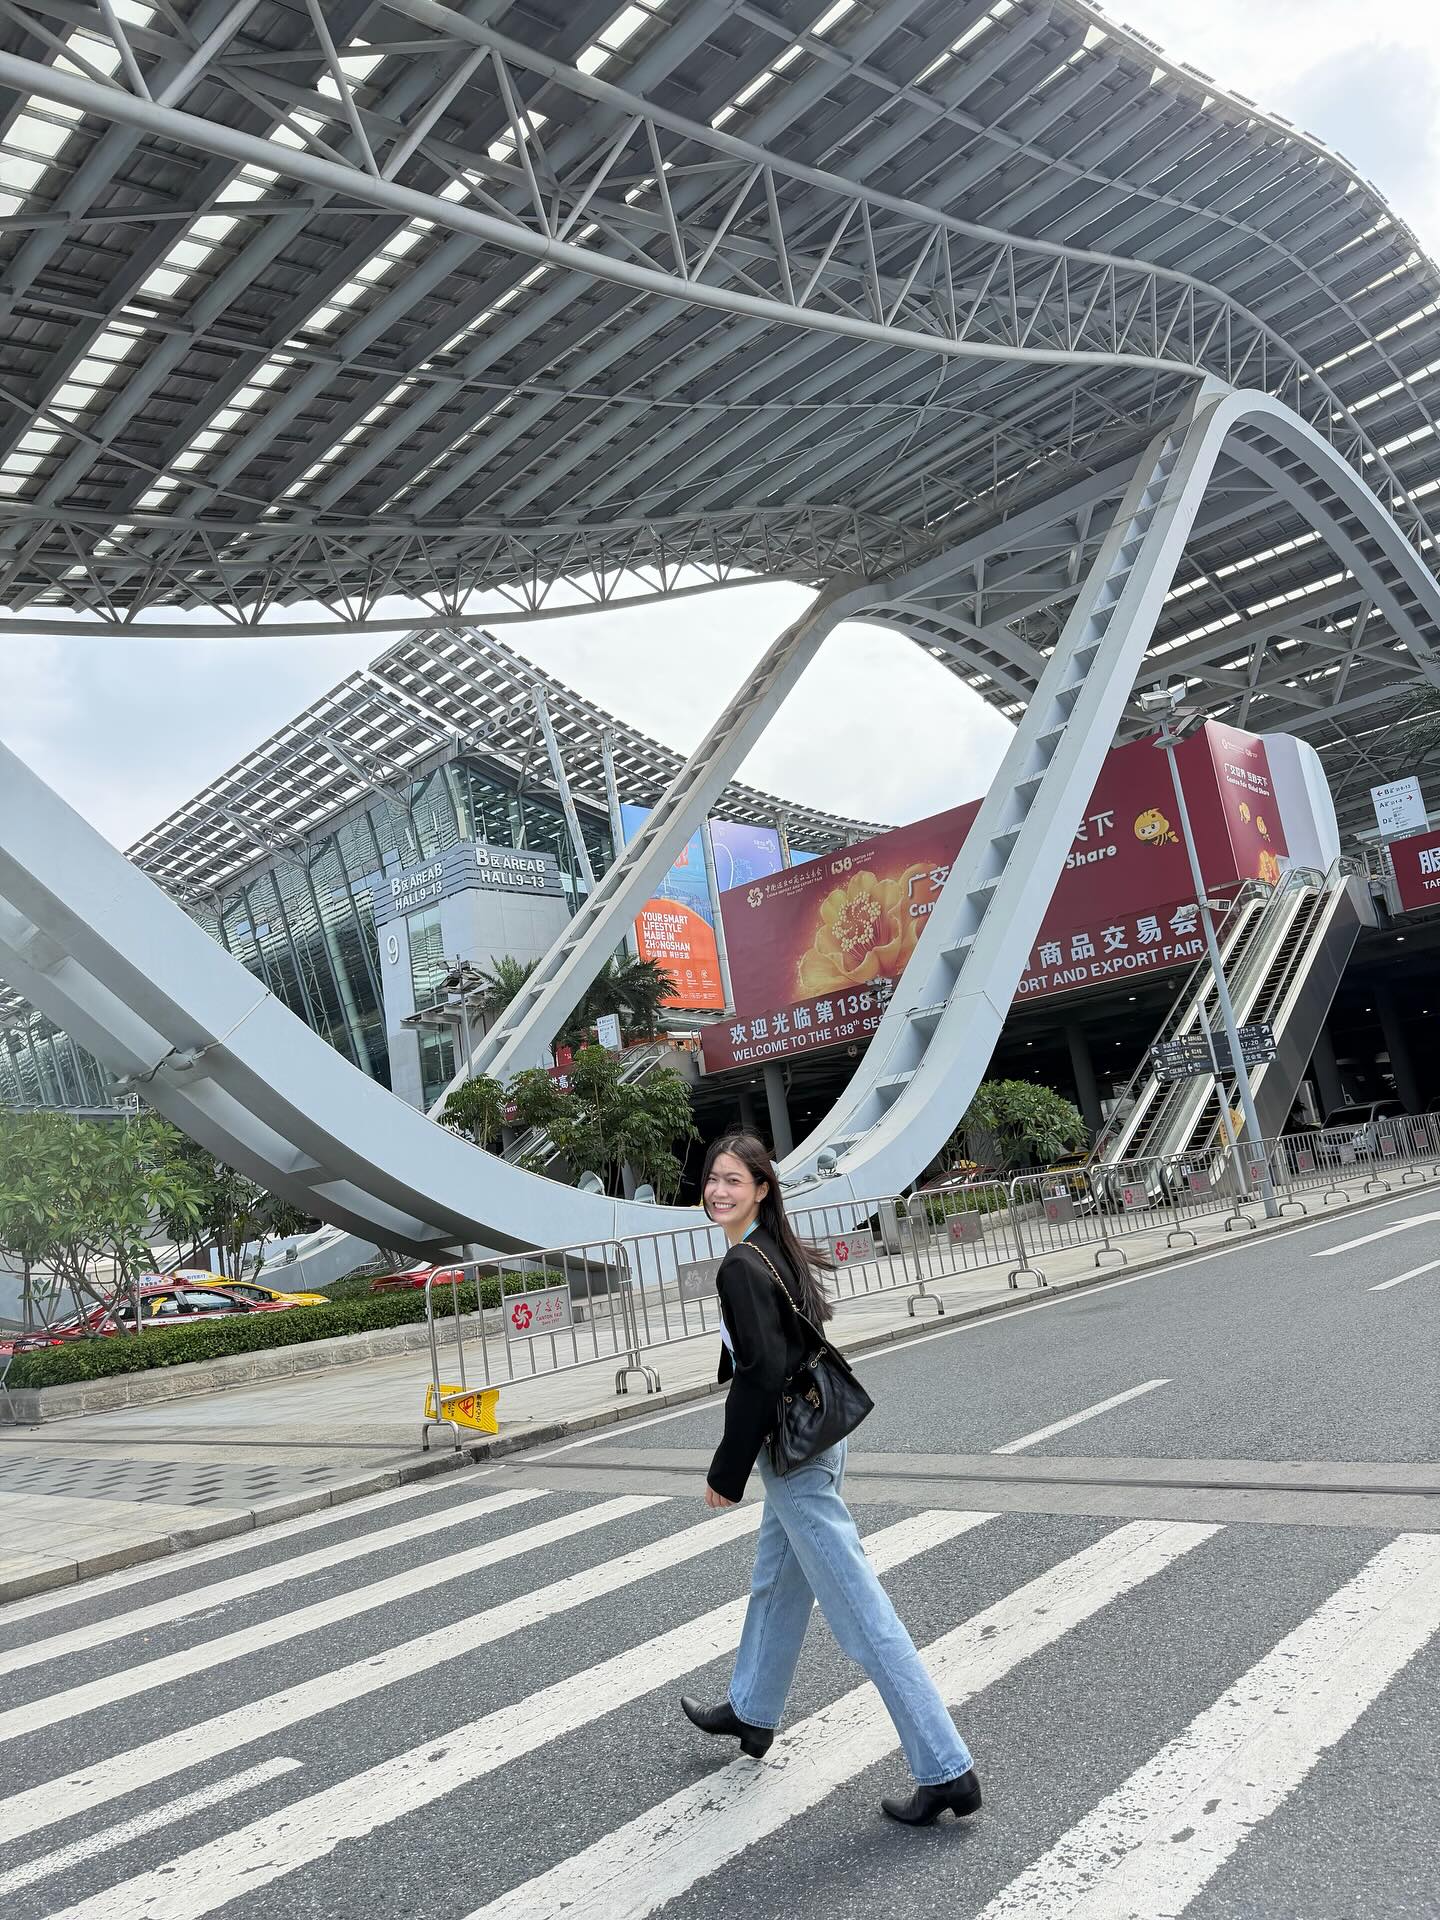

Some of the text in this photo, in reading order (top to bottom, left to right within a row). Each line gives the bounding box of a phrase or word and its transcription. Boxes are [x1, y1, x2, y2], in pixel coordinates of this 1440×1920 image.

[502, 854, 536, 873] AREA
[535, 859, 546, 873] B
[831, 856, 852, 875] 138
[1066, 845, 1117, 869] Share
[409, 868, 434, 890] AREA
[433, 862, 443, 878] B
[641, 911, 689, 925] YOUR SMART
[642, 921, 682, 933] LIFESTYLE
[645, 939, 691, 951] ZHONGSHAN
[666, 932, 675, 942] IN
[386, 935, 399, 965] 9
[1052, 966, 1088, 987] AND
[1090, 949, 1159, 977] EXPORT
[1162, 939, 1204, 960] FAIR
[733, 1038, 789, 1062] WELCOME
[790, 1034, 807, 1048] TO
[808, 1028, 832, 1044] THE
